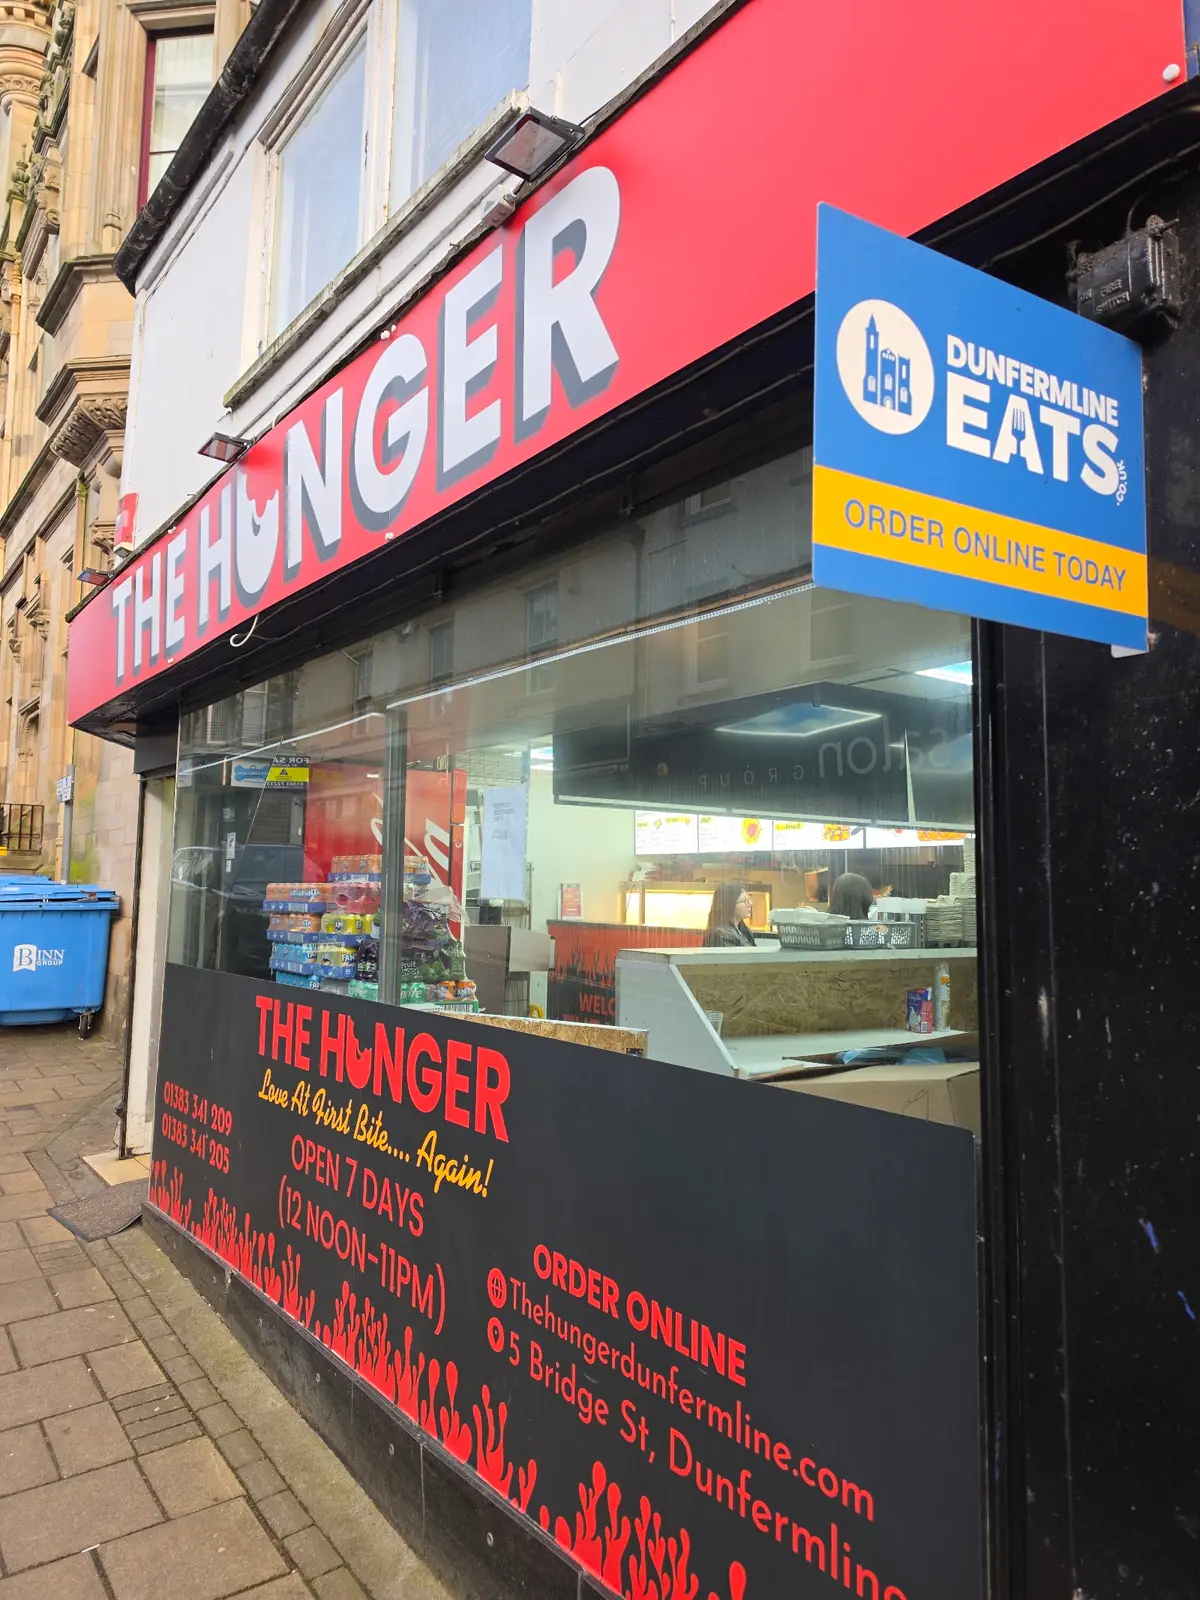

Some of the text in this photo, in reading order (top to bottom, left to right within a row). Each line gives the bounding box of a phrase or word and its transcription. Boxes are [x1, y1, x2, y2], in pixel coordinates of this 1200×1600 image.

[111, 165, 620, 684] THE HUNGER
[947, 335, 1119, 427] DUNFERMLINE
[947, 372, 1120, 496] EATS
[844, 499, 1127, 592] ORDER ONLINE TODAY
[163, 1081, 233, 1137] 01383 341 209
[256, 994, 511, 1144] THE HUNGER
[258, 1068, 494, 1198] Love At First Bite.... Again!
[161, 1112, 230, 1175] 01383 341 205
[291, 1134, 425, 1238] OPEN 7 DAYS
[278, 1175, 446, 1336] (12 NOON-11PM)
[533, 1244, 747, 1387] ORDER ONLINE
[509, 1330, 521, 1367] 5
[529, 1341, 610, 1426] Bridge
[619, 1399, 656, 1464] St,
[509, 1277, 875, 1522] Thehungerdunfermline.com
